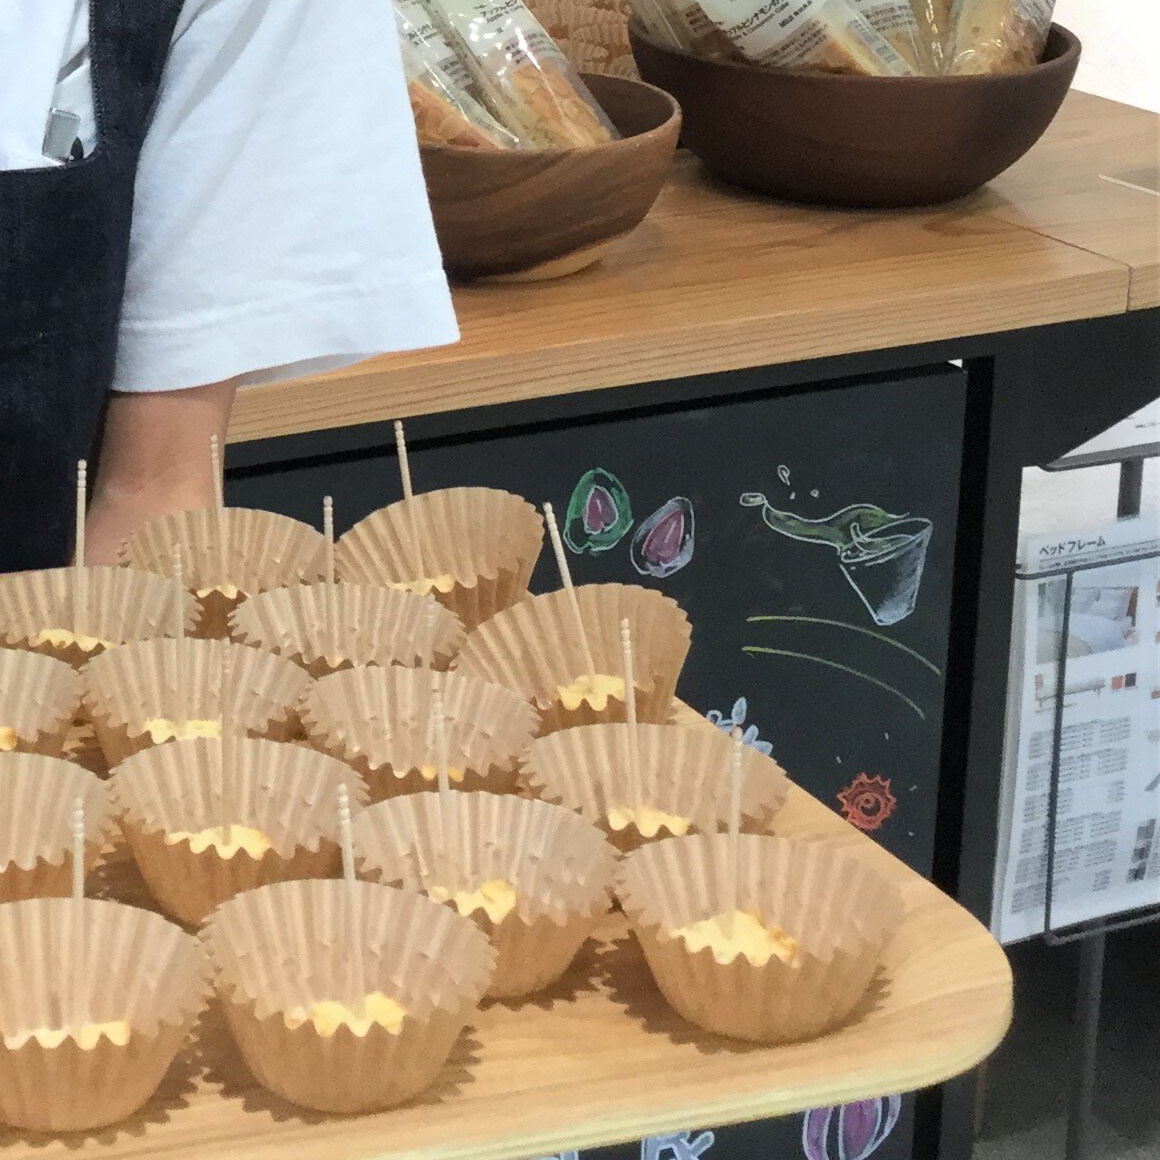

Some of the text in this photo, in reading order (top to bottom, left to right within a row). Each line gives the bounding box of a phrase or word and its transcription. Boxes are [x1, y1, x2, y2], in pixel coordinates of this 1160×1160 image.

[1039, 536, 1106, 555] ベッドフレーム
